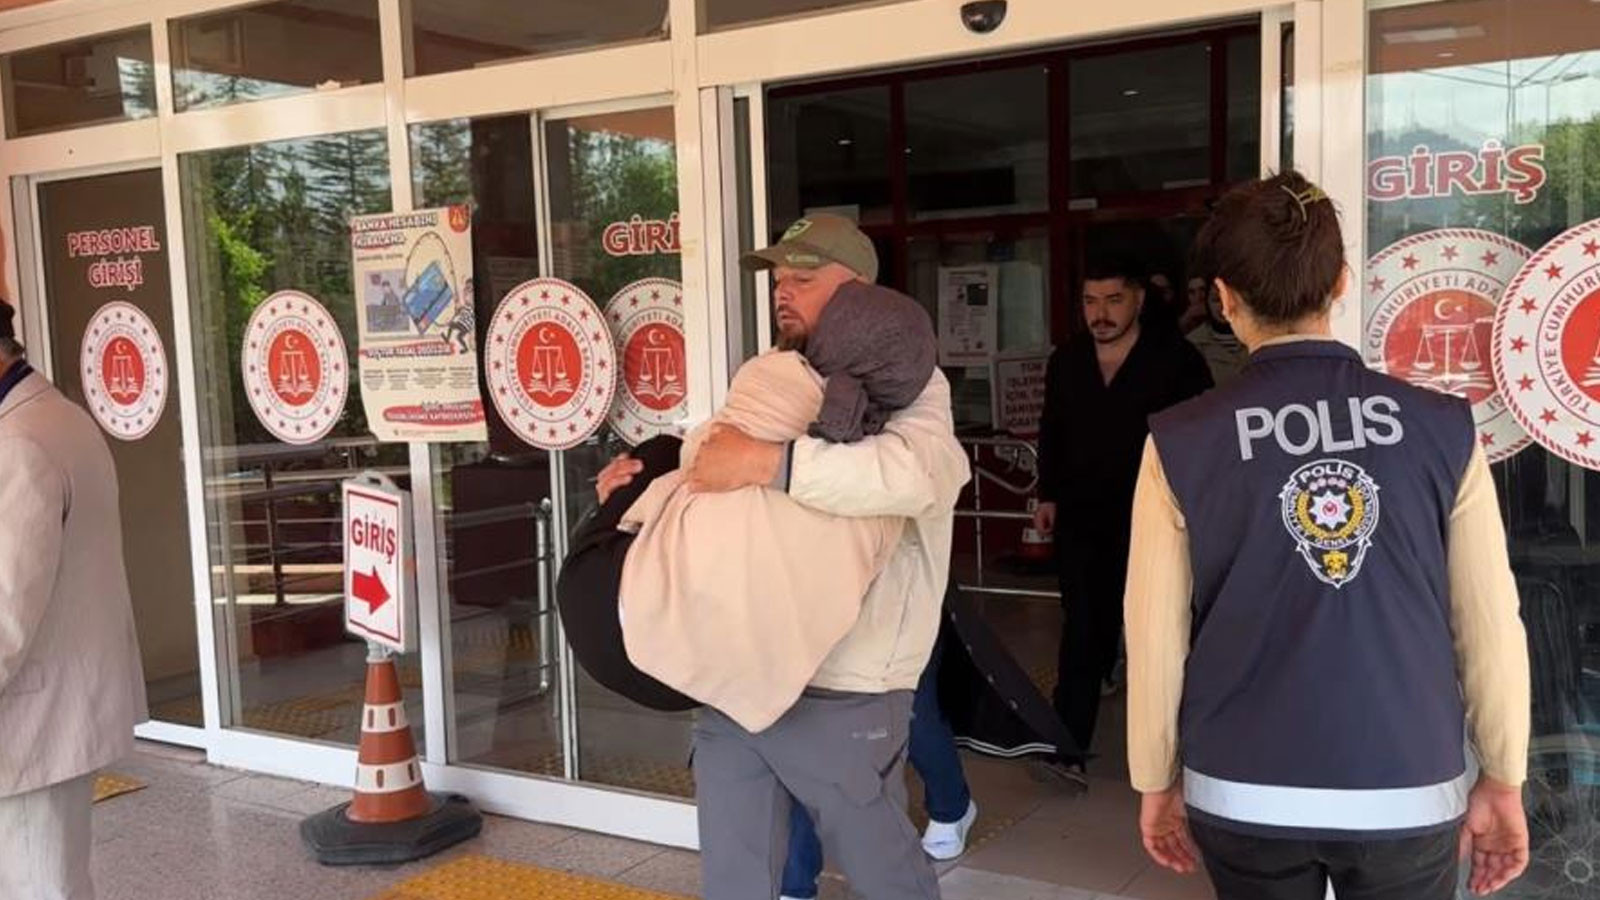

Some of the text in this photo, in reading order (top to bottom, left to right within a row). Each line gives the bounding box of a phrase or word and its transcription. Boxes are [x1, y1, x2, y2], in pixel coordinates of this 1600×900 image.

[1367, 138, 1546, 205] GİRİŞ
[67, 226, 160, 258] PERSONEL
[602, 213, 681, 258] GİRİ
[88, 256, 144, 291] GİRİŞİ
[1371, 275, 1459, 349] CUMHURİYETİ
[1545, 270, 1600, 415] TÜRKİYE CUMHURİ
[1235, 395, 1404, 461] POLIS
[351, 513, 396, 565] GİRİŞ
